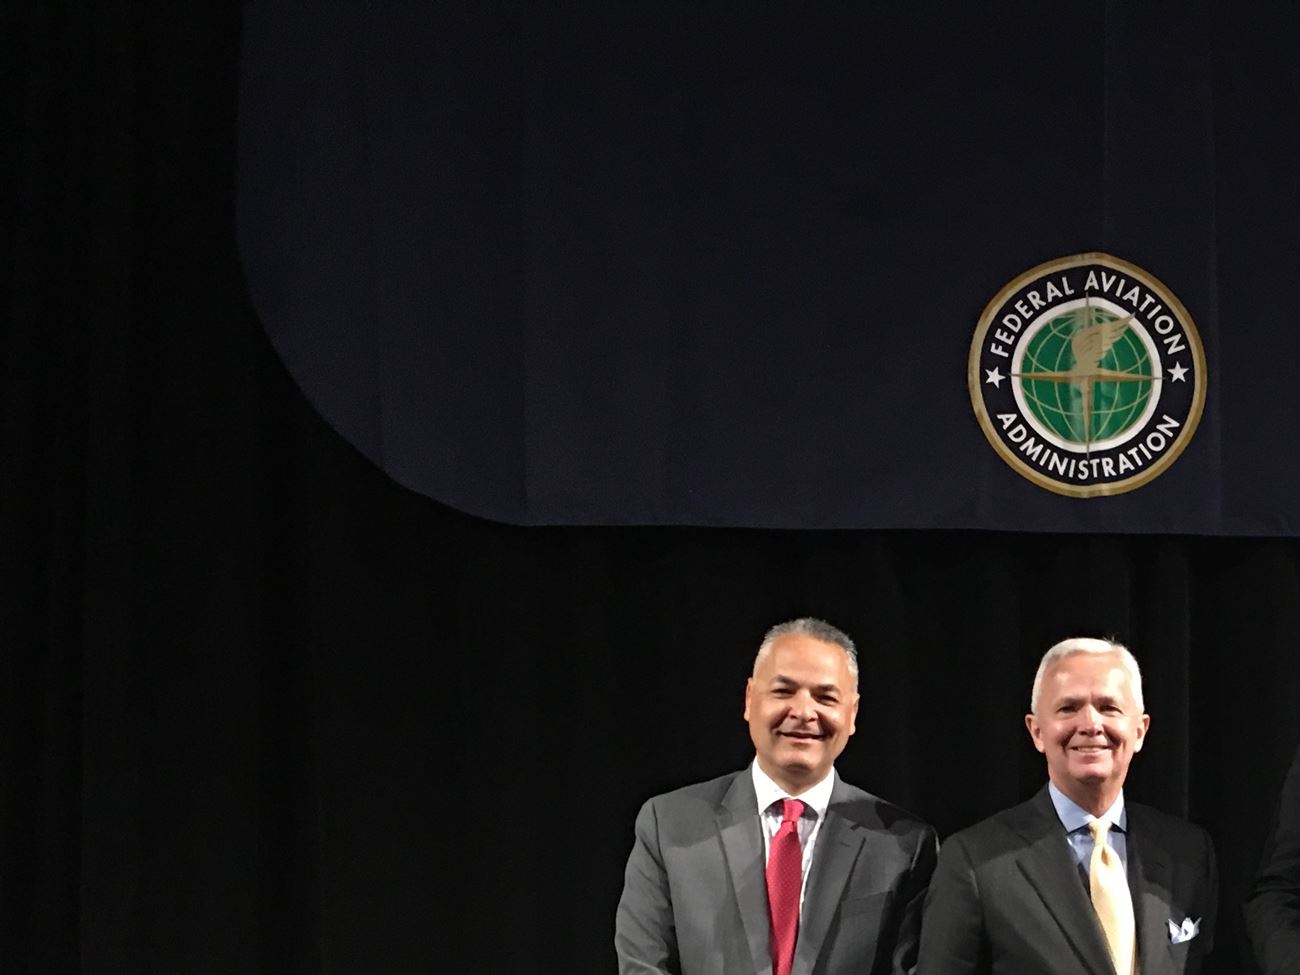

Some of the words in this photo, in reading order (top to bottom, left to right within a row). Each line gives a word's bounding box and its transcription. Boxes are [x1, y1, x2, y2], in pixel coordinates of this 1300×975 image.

[990, 275, 1075, 358] FEDERAL
[1083, 269, 1186, 356] AVIATION
[996, 412, 1181, 481] ADMINISTRATION
